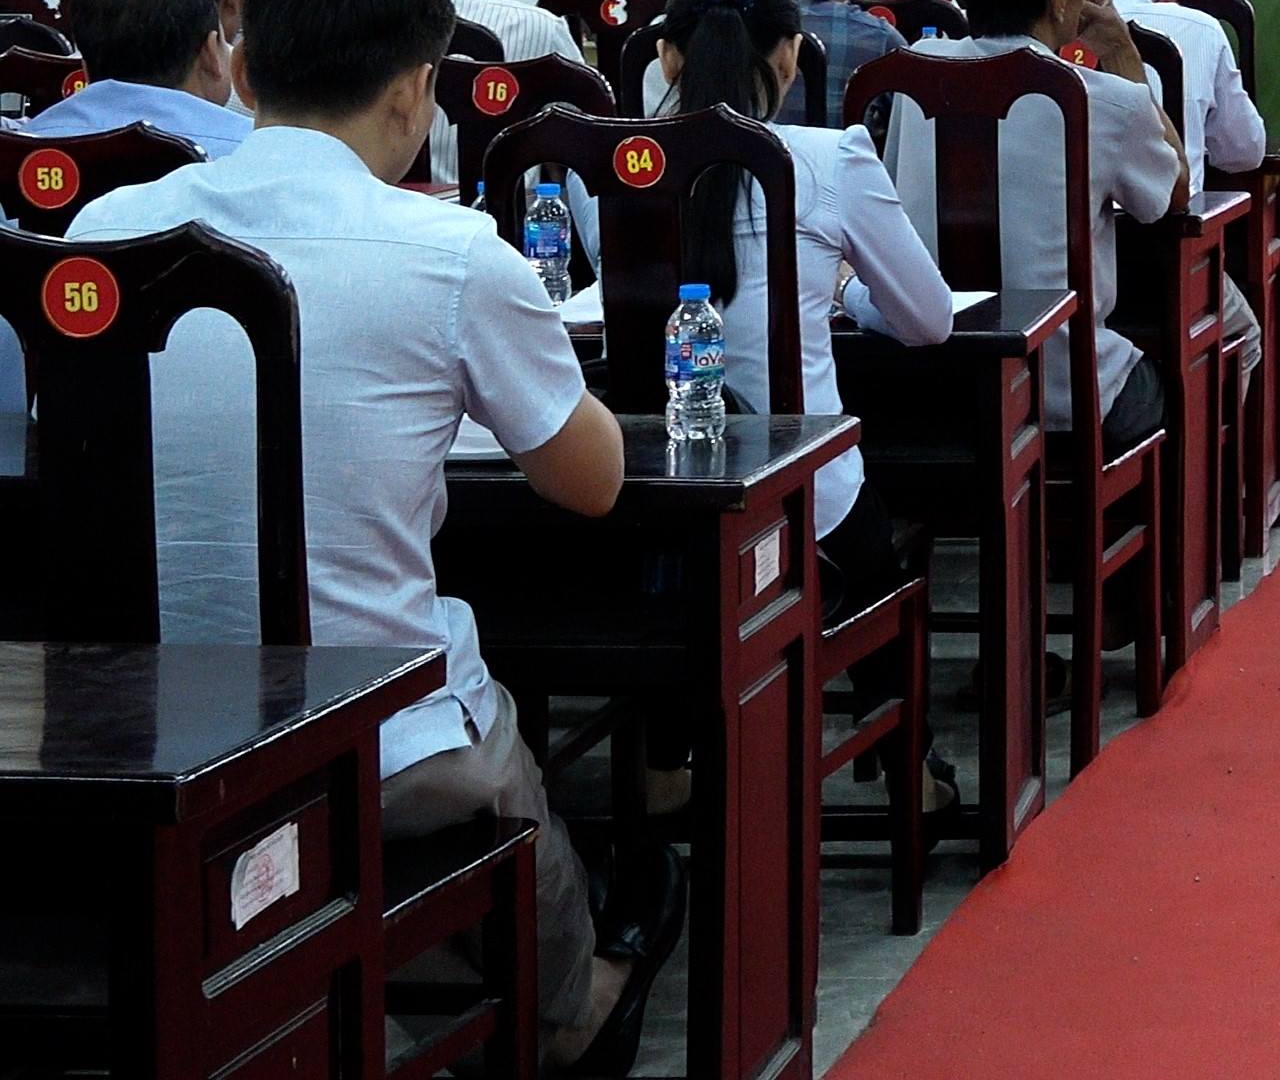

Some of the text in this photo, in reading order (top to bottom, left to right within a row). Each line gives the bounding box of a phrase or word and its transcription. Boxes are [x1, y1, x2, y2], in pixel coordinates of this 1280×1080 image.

[1074, 49, 1085, 65] 2
[487, 81, 508, 102] 16
[625, 150, 654, 175] 84
[36, 166, 63, 190] 58
[63, 281, 99, 312] 56
